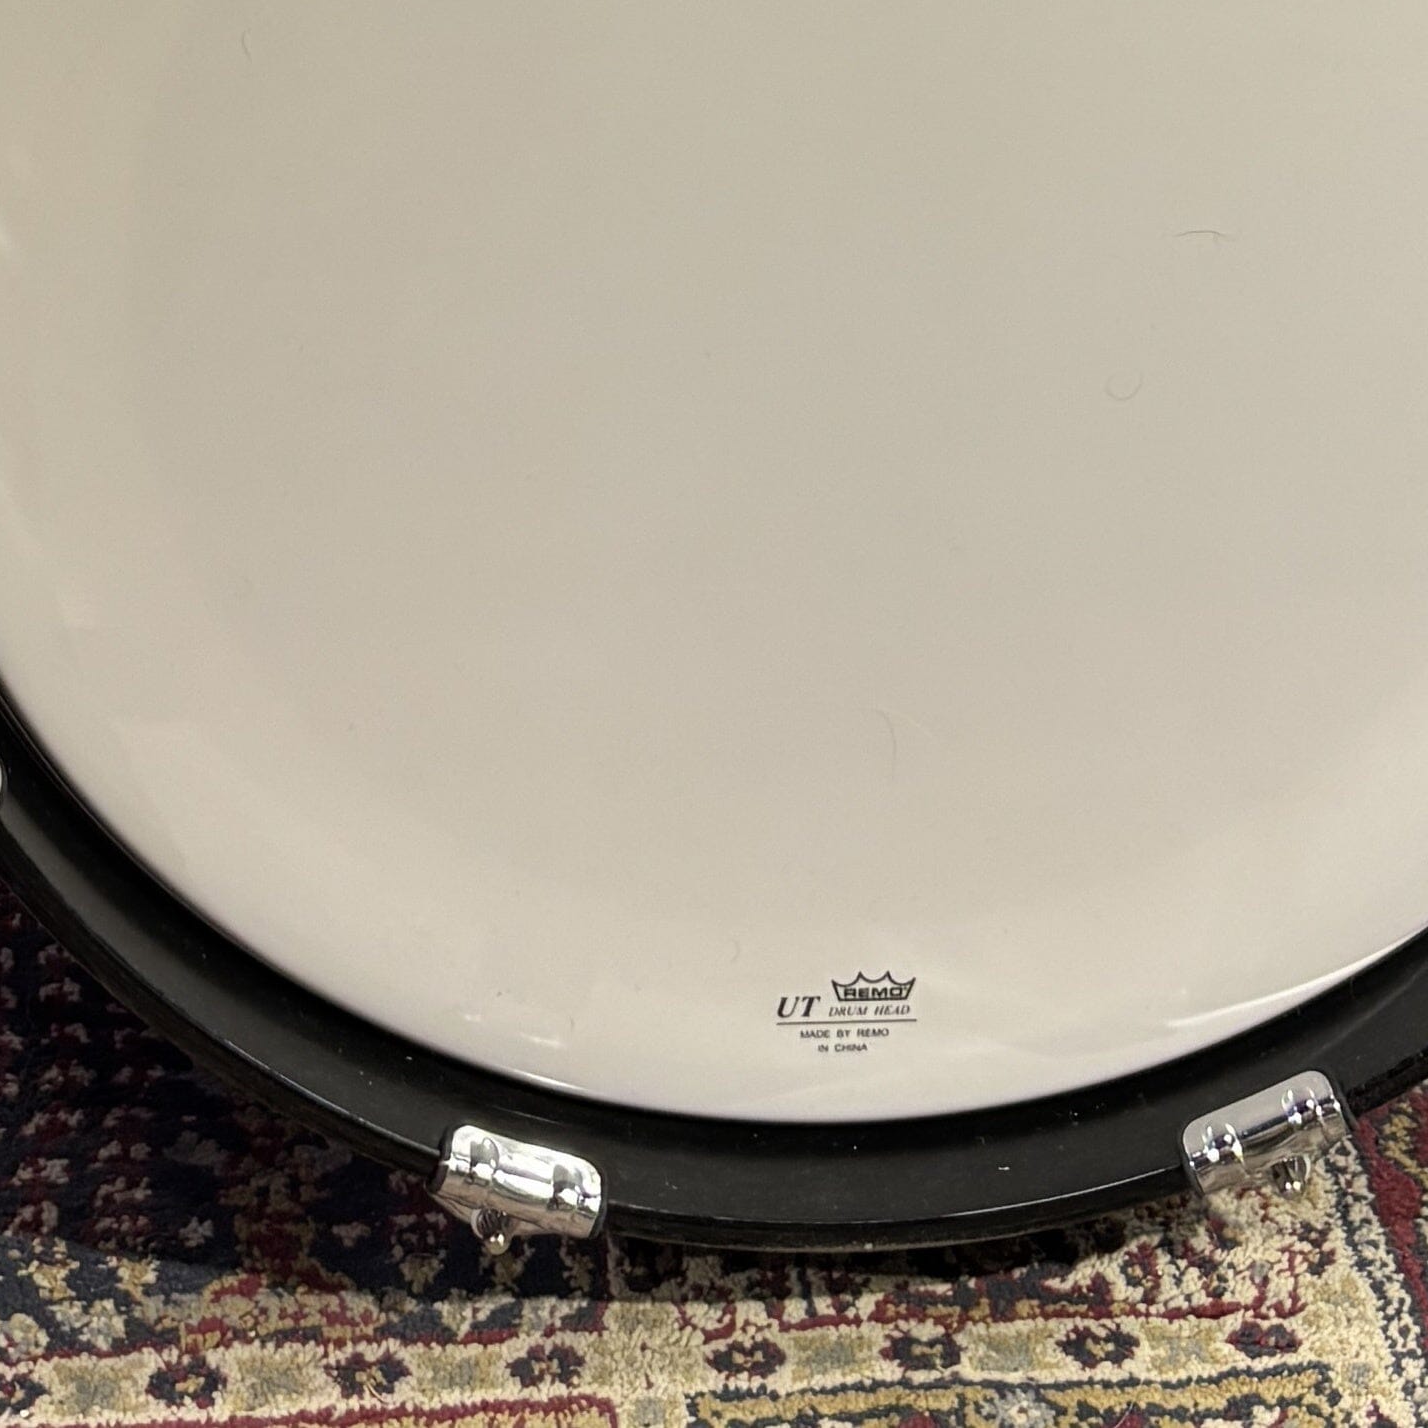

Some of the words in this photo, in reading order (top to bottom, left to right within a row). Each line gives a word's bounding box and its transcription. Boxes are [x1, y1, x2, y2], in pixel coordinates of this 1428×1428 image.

[844, 987, 904, 999] REMO
[776, 996, 821, 1018] UT
[828, 1005, 869, 1017] DRUM
[874, 1004, 911, 1016] HEAD
[800, 1029, 830, 1039] MADE
[836, 1029, 851, 1038] BY
[856, 1028, 890, 1038] REMO
[817, 1044, 830, 1053] IN
[834, 1043, 868, 1053] CHINA
